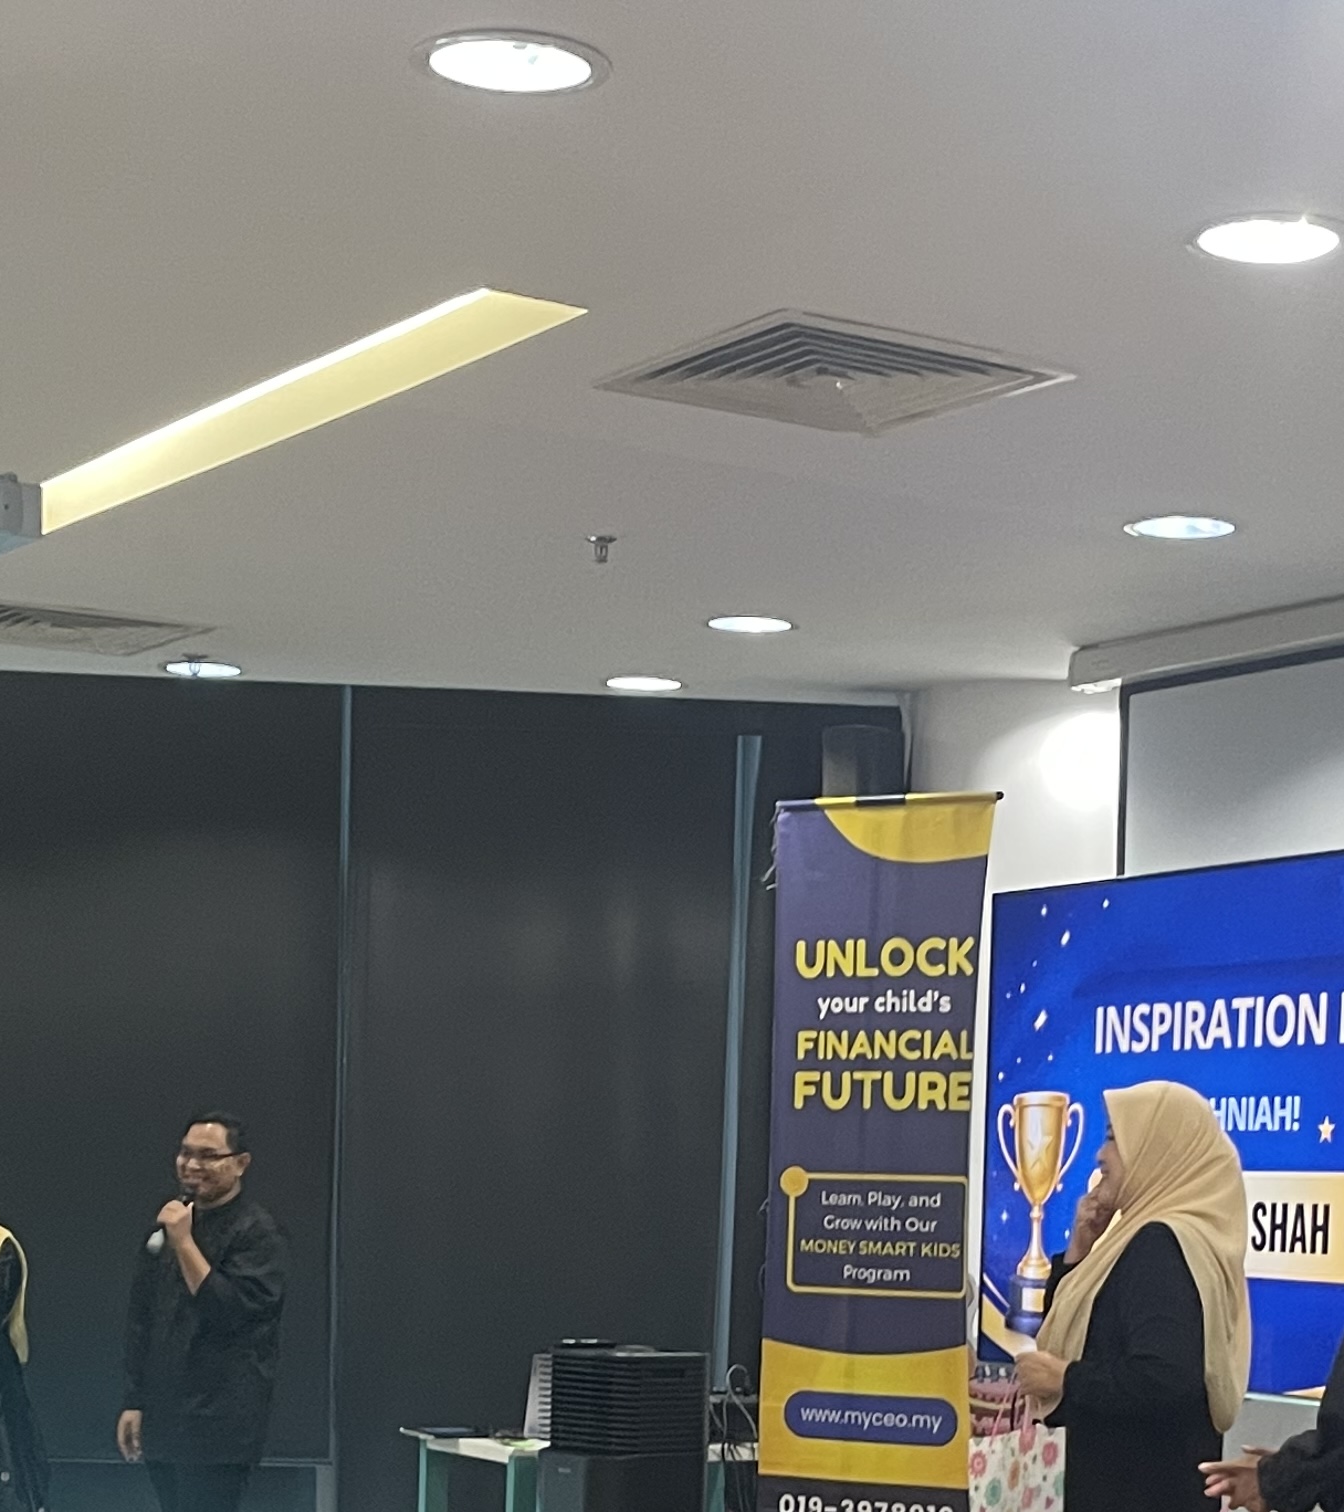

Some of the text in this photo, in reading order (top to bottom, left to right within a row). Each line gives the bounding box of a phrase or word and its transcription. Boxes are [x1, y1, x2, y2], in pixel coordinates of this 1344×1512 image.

[795, 936, 975, 979] UNLOCK
[817, 989, 952, 1020] your child's
[1095, 992, 1328, 1055] INSPIRATION
[797, 1029, 973, 1061] FINANCIAL
[793, 1070, 973, 1111] FUTURE
[1209, 1095, 1301, 1132] HNIAH!
[867, 1191, 905, 1210] Play,
[908, 1193, 942, 1208] and
[823, 1214, 938, 1233] Grow with Our
[1251, 1201, 1331, 1255] SHAH
[800, 1239, 961, 1258] MONEY SMART KIDS
[843, 1264, 911, 1283] Program
[800, 1407, 943, 1434] www.myceo.my
